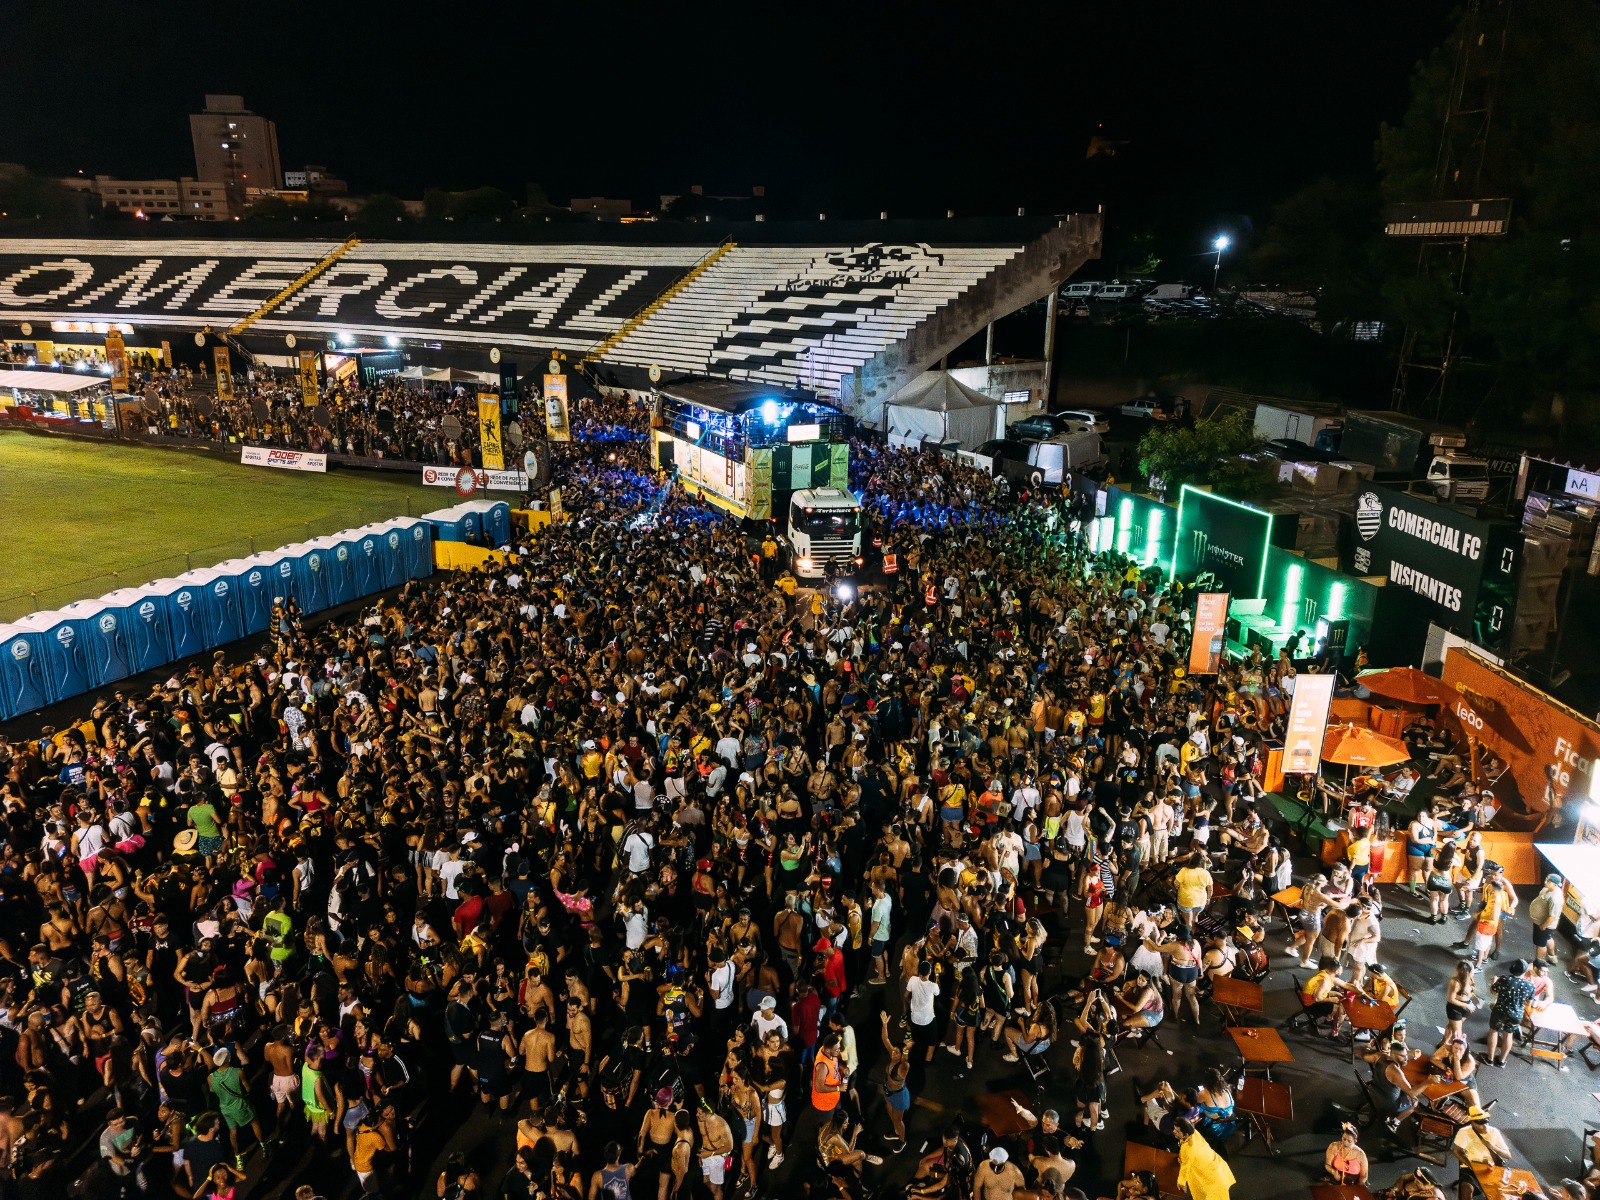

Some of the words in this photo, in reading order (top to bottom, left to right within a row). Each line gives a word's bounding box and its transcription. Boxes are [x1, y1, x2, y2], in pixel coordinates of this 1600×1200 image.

[1388, 506, 1460, 554] COMERCIAL
[1461, 533, 1481, 560] FC
[1207, 543, 1244, 566] MONSTER
[1390, 559, 1462, 612] VISITANTES
[1456, 702, 1483, 730] leão
[1554, 736, 1589, 775] Fica
[1550, 762, 1570, 788] de
